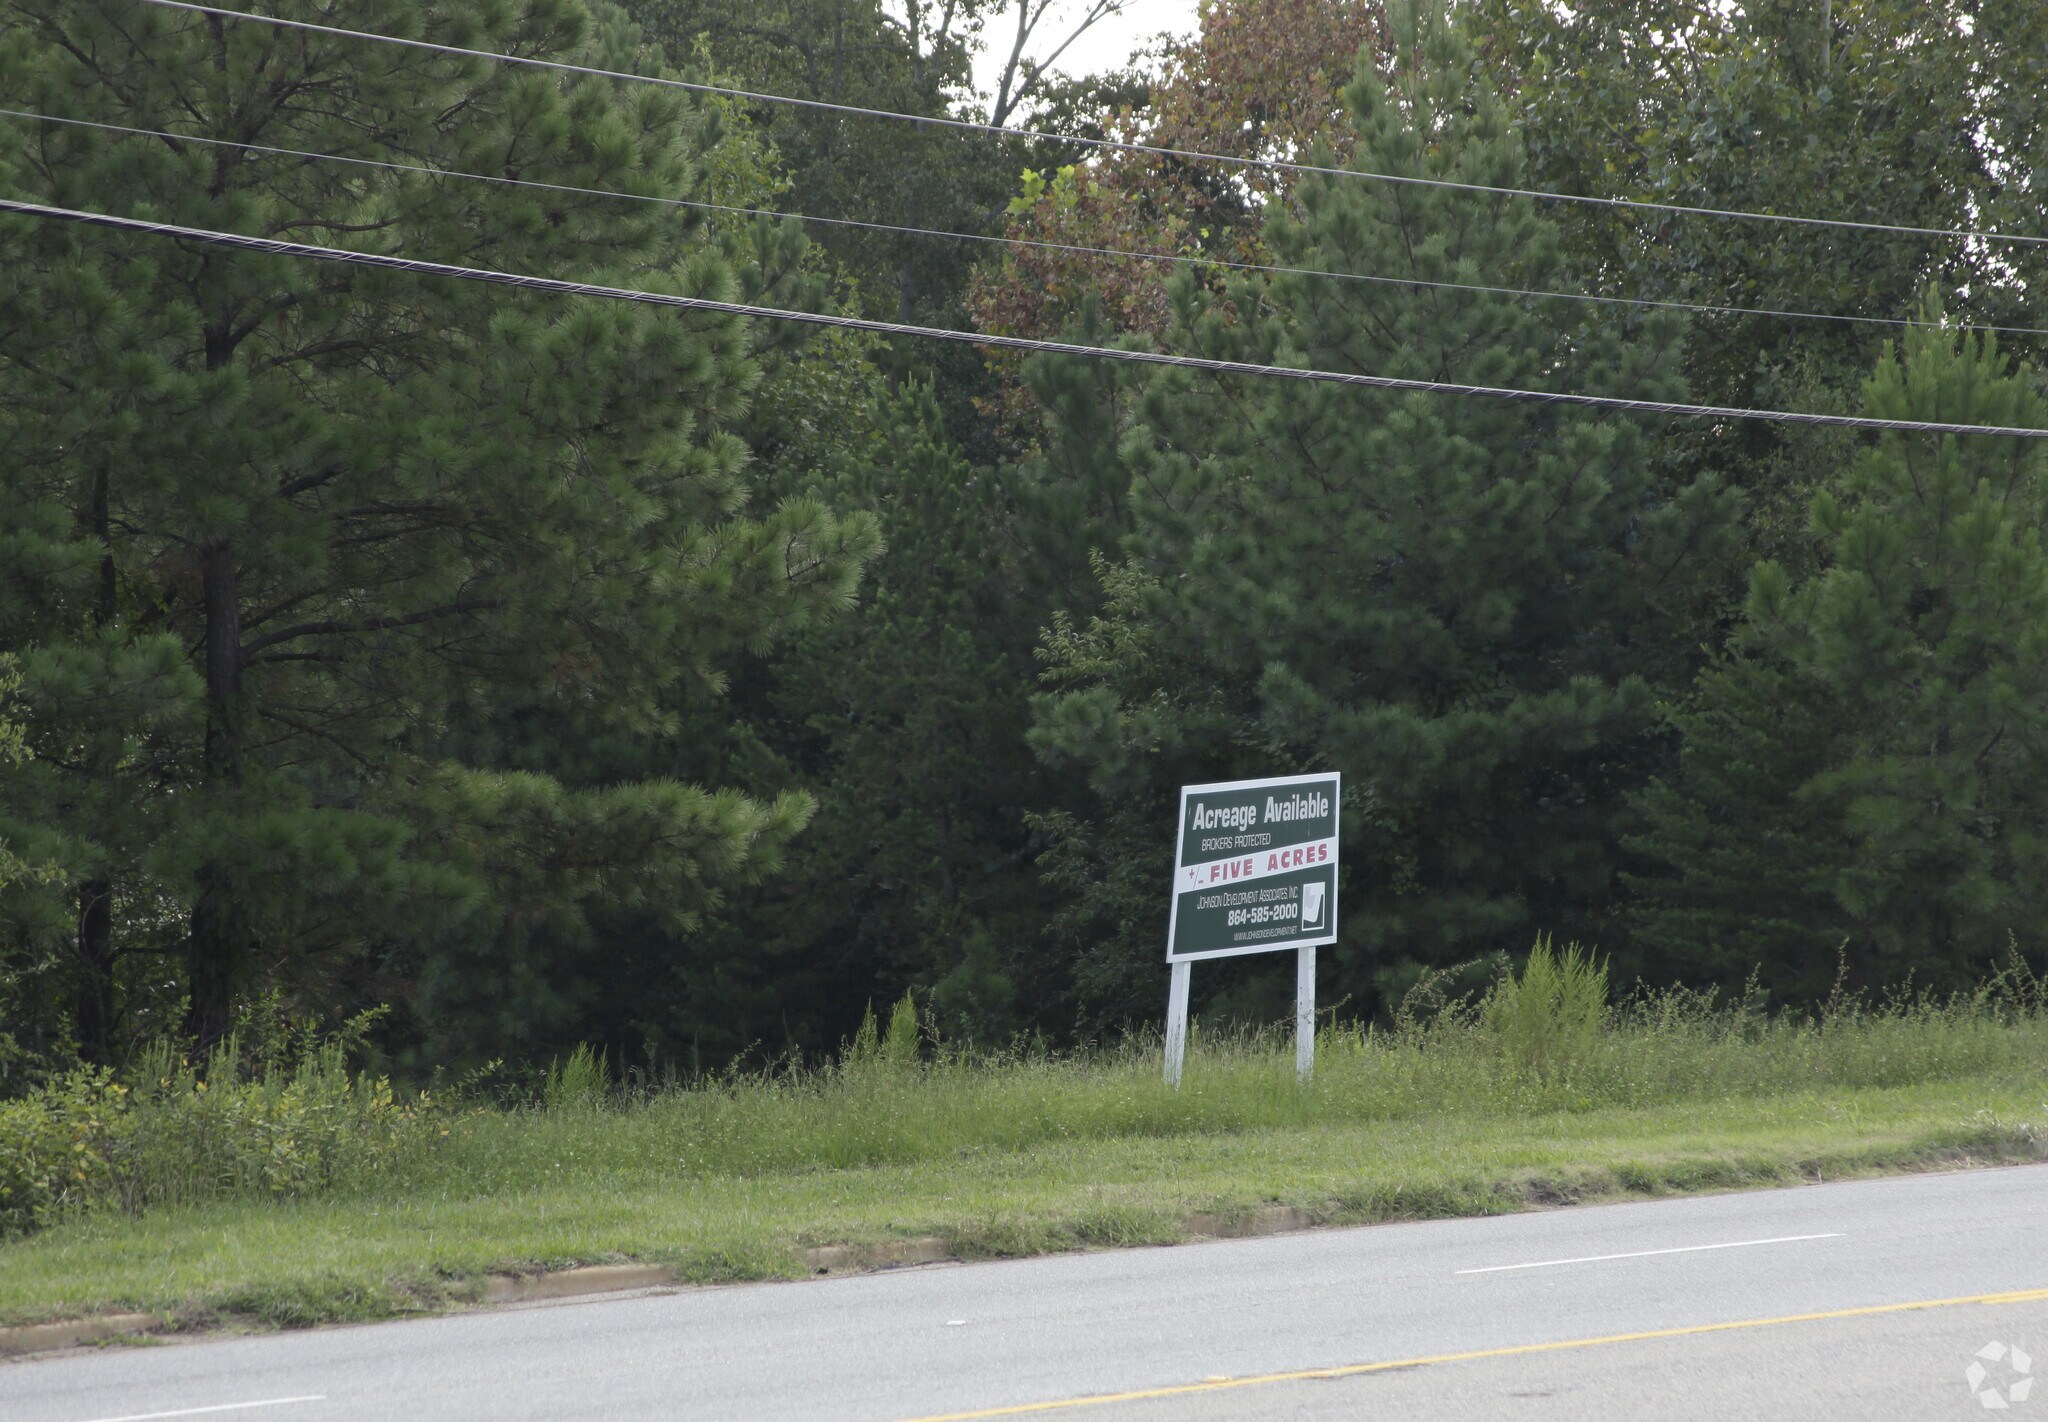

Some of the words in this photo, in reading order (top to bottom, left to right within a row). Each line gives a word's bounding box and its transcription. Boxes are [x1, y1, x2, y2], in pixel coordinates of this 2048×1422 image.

[1192, 803, 1257, 831] Acreage
[1263, 792, 1329, 823] Available
[1201, 837, 1233, 851] BROKERS
[1234, 833, 1271, 848] PROTECTED
[1210, 858, 1253, 882] FIVE
[1267, 843, 1328, 871] ACRES
[1227, 903, 1298, 926] 864-585-2000
